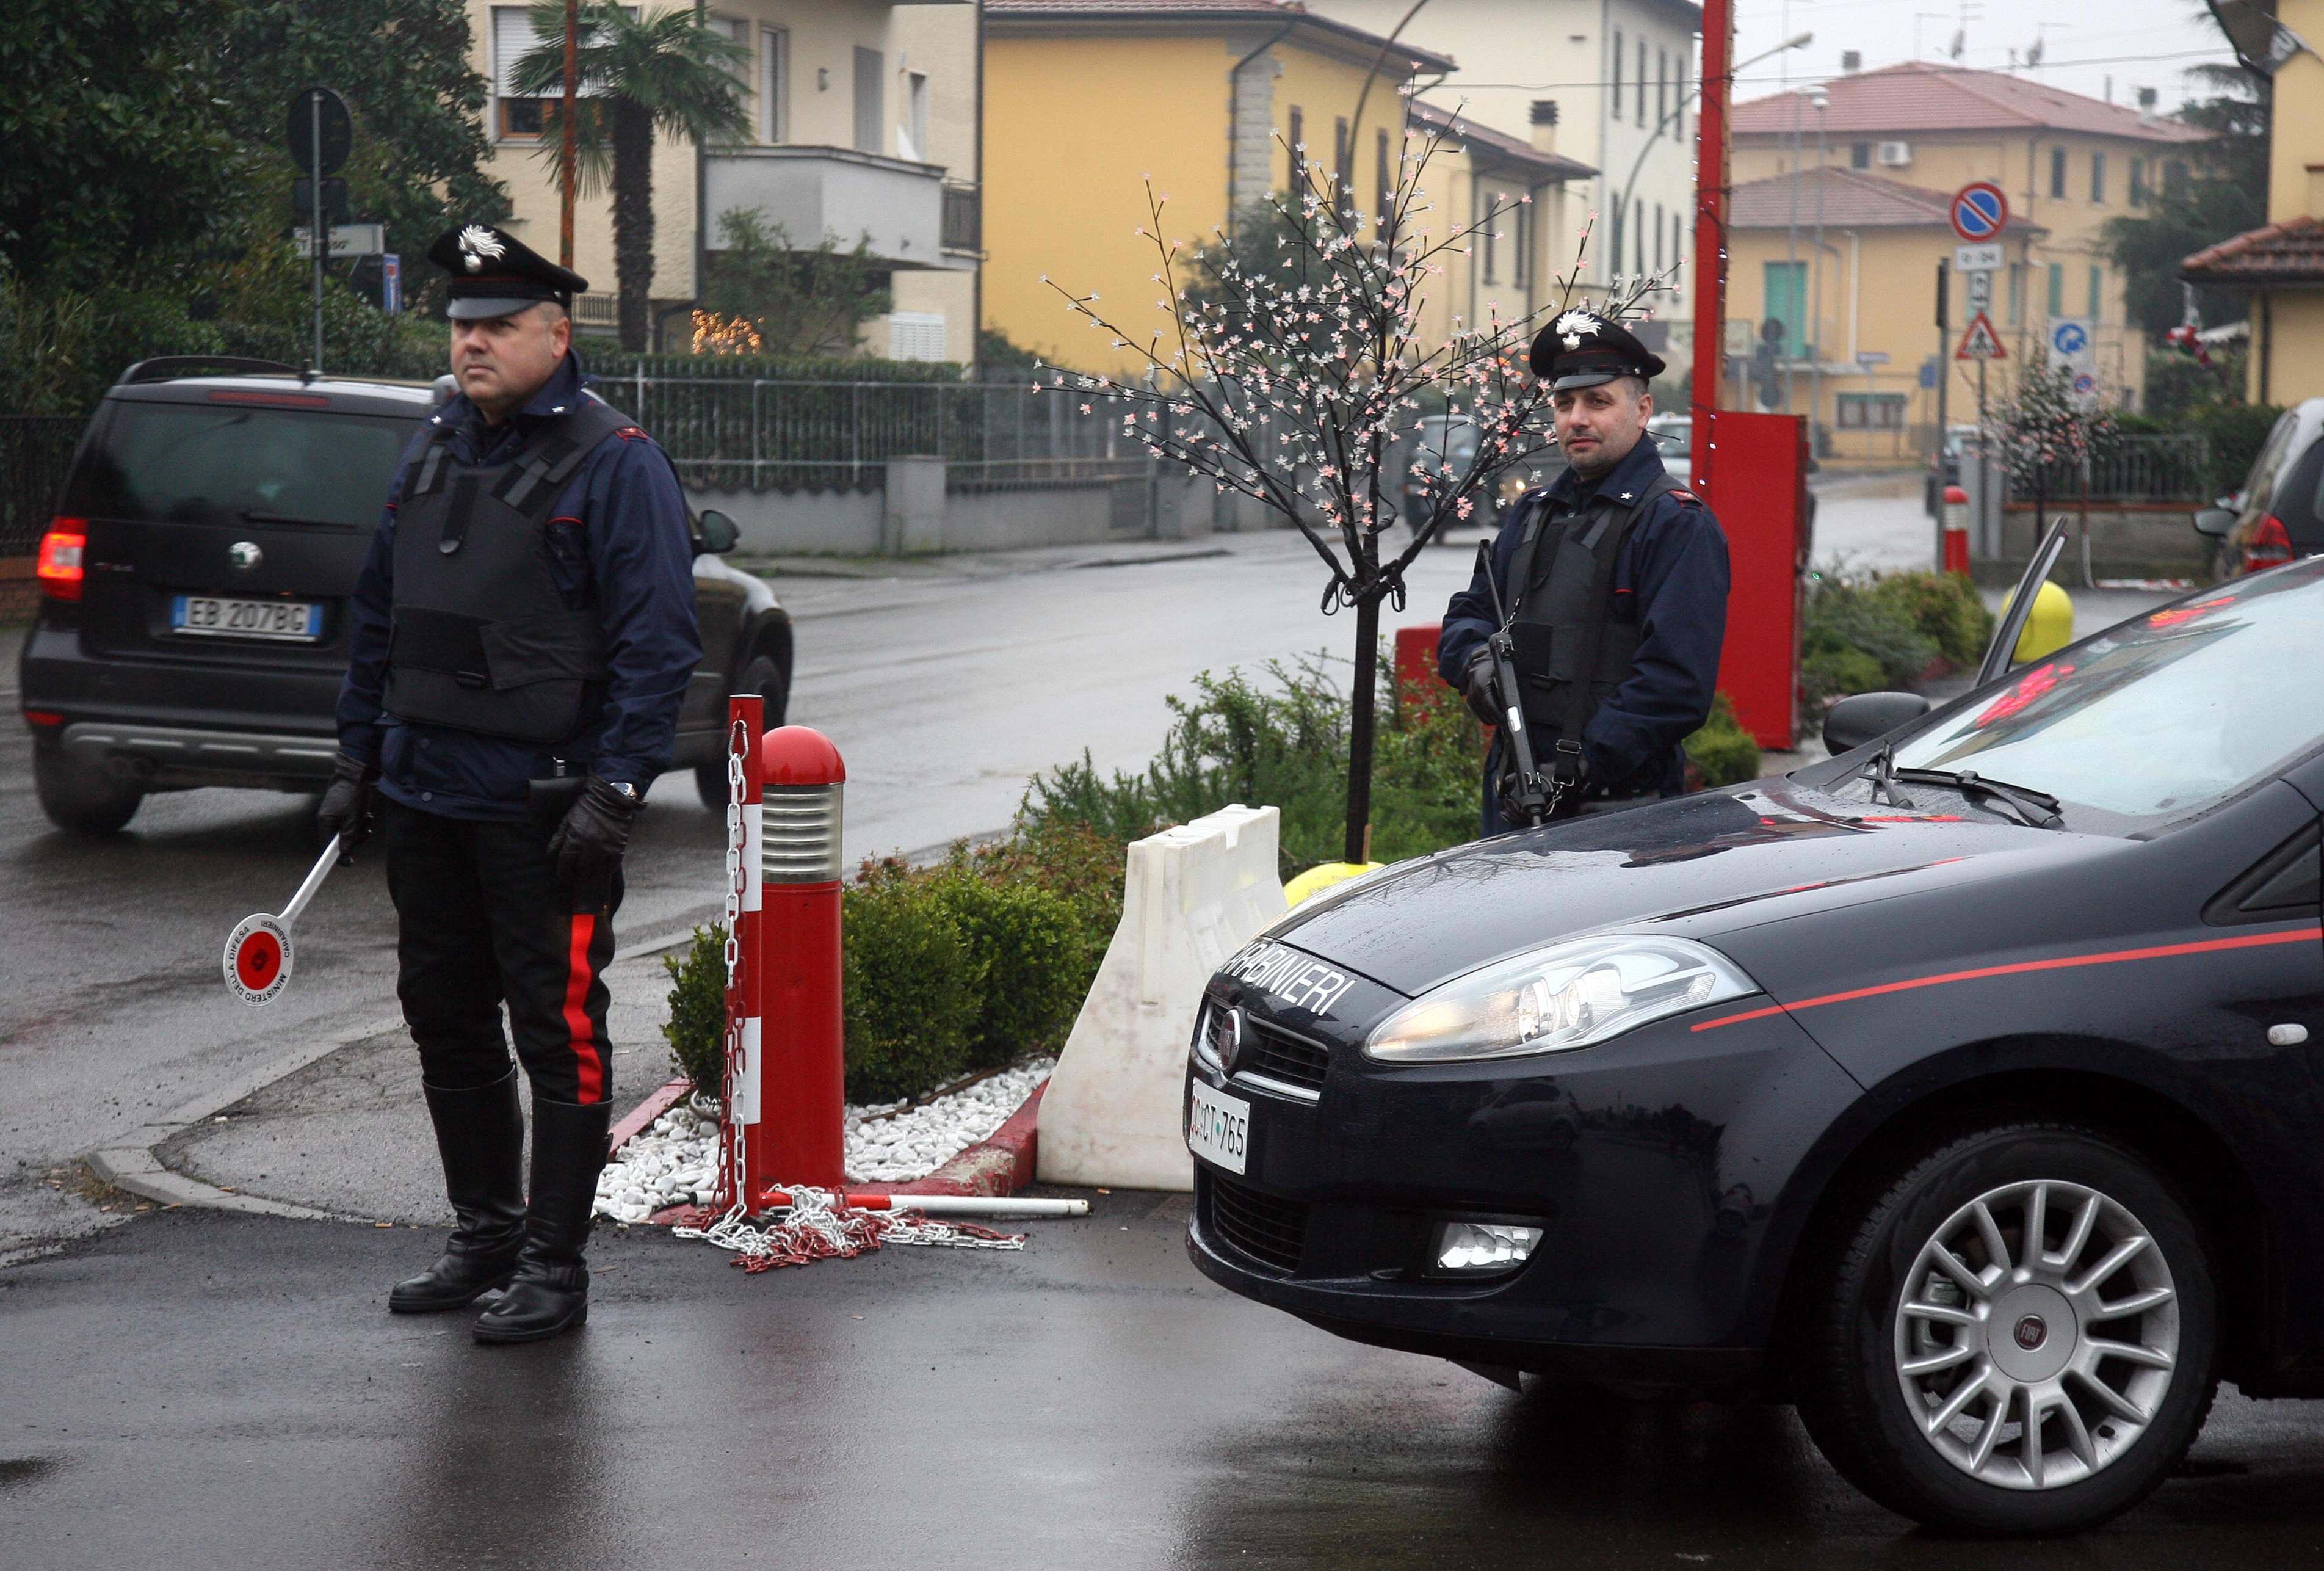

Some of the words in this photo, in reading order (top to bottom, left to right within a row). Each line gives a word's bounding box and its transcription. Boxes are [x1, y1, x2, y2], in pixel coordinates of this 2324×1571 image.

[190, 600, 220, 626] EB
[227, 602, 305, 632] 207BG
[228, 926, 250, 960] DIFESA
[228, 963, 244, 996] DELLA
[245, 973, 286, 1003] MINISTERO
[1216, 941, 1356, 1016] ARABINIERI
[1203, 1103, 1216, 1145] CT
[1220, 1110, 1245, 1157] 765
[2021, 1323, 2041, 1343] FIAT
